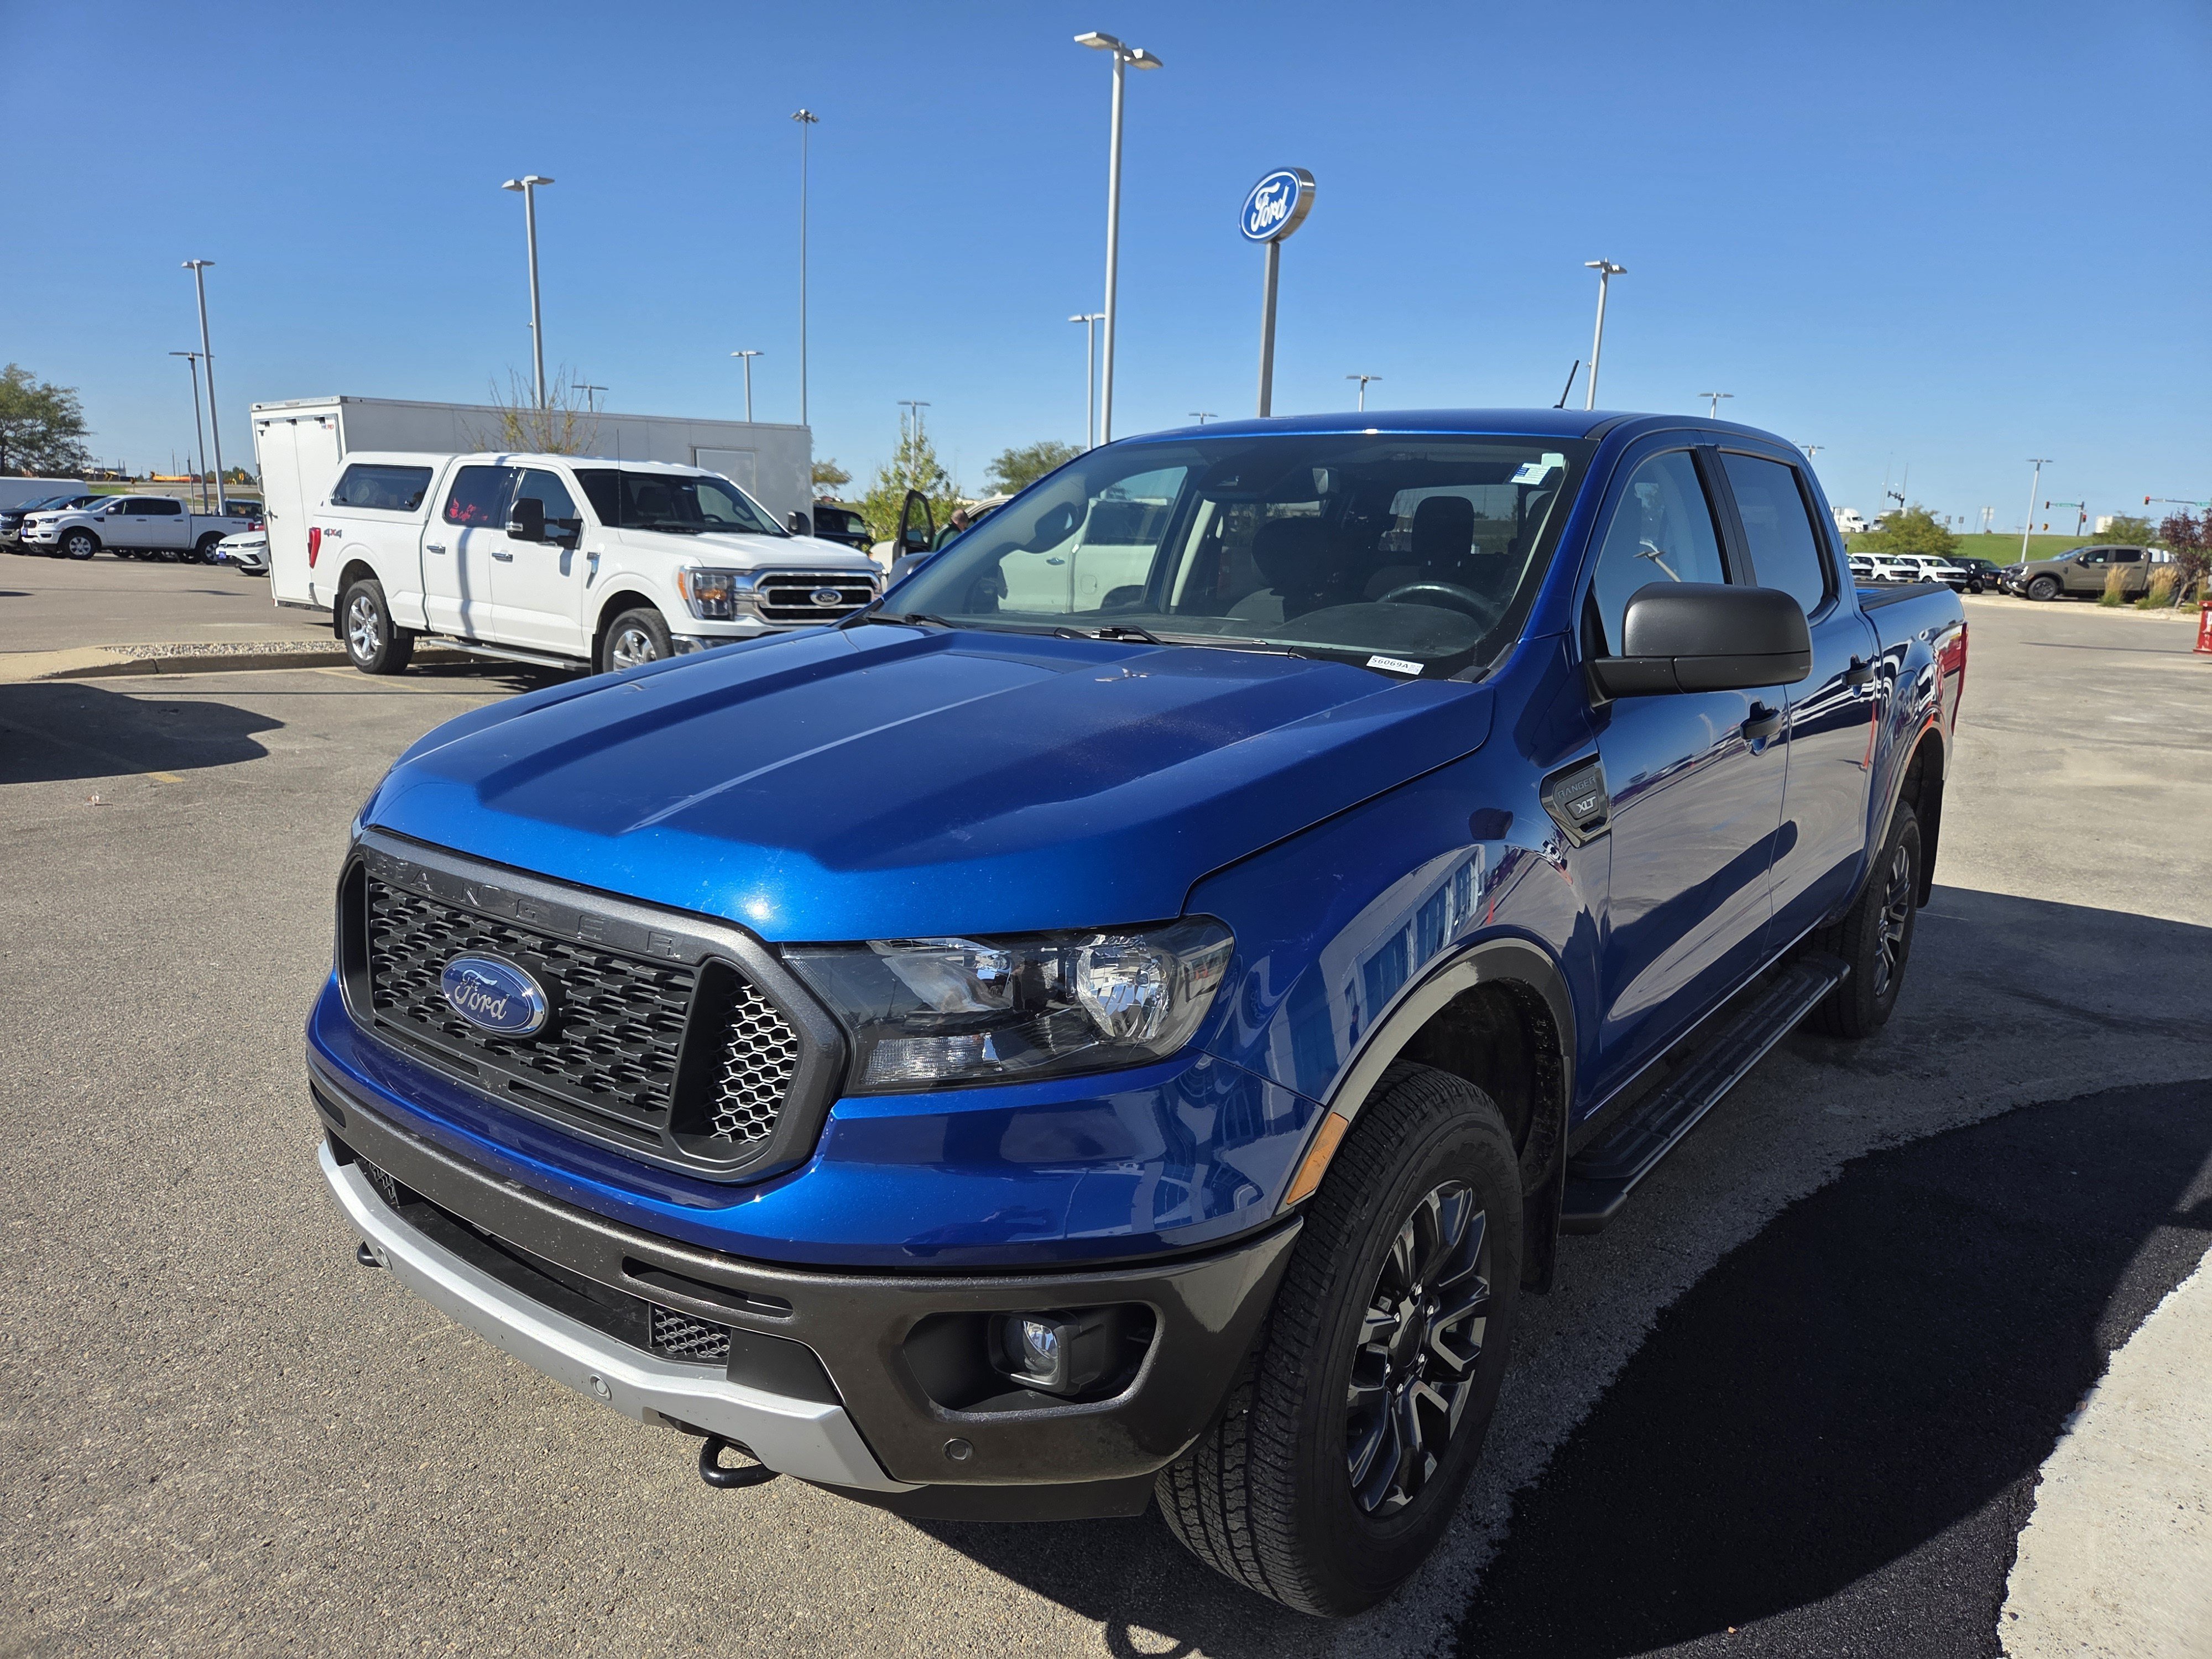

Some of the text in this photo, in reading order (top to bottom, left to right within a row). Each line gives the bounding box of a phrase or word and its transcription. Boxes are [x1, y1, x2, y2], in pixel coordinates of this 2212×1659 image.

[1251, 181, 1289, 232] Ford
[1557, 776, 1597, 800] RANGER
[1576, 796, 1597, 814] XLT
[372, 852, 677, 959] RANGER
[454, 969, 510, 1020] Ford
